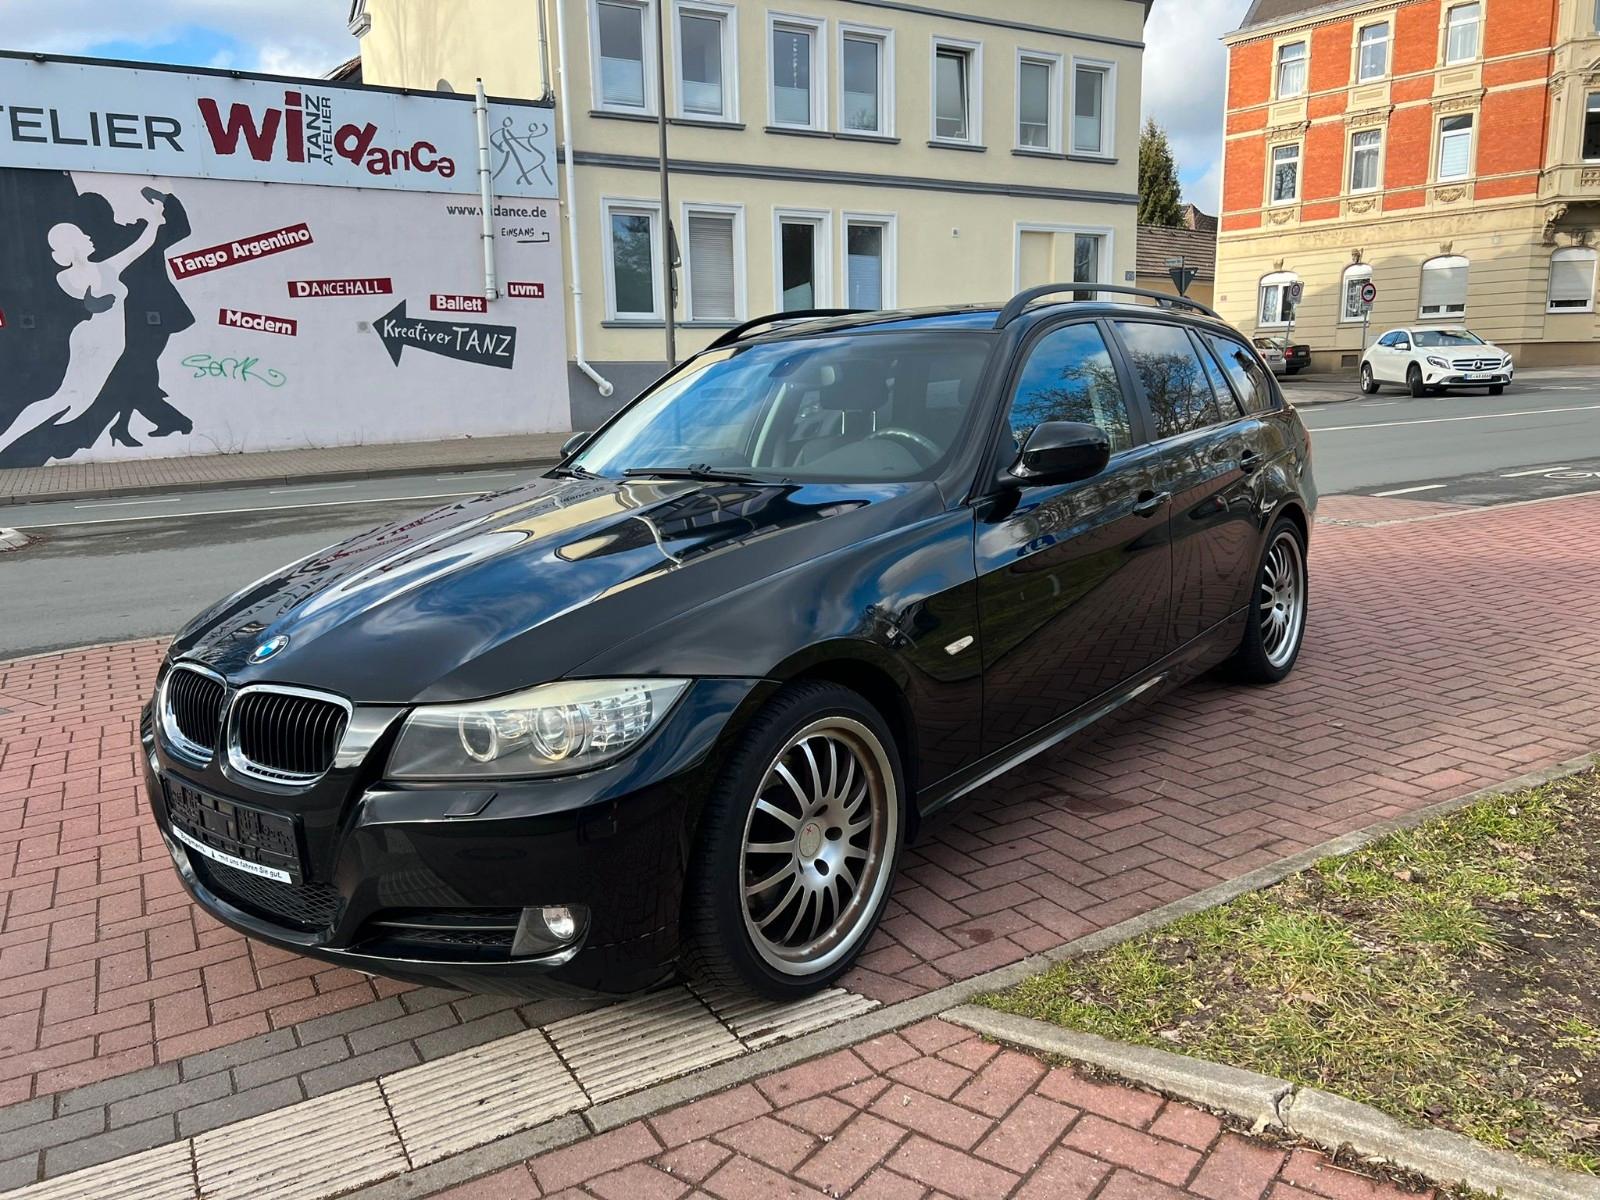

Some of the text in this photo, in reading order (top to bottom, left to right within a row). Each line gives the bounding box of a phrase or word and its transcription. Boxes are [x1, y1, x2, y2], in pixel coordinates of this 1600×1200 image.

[0, 105, 184, 152] ELIER
[305, 94, 321, 163] TANZ
[321, 97, 333, 166] ATELIER
[173, 229, 310, 274] Tango Argentino
[296, 280, 384, 297] DANCEHALL
[436, 296, 483, 311] Ballett
[510, 284, 542, 296] uvm.
[225, 310, 292, 335] Modern
